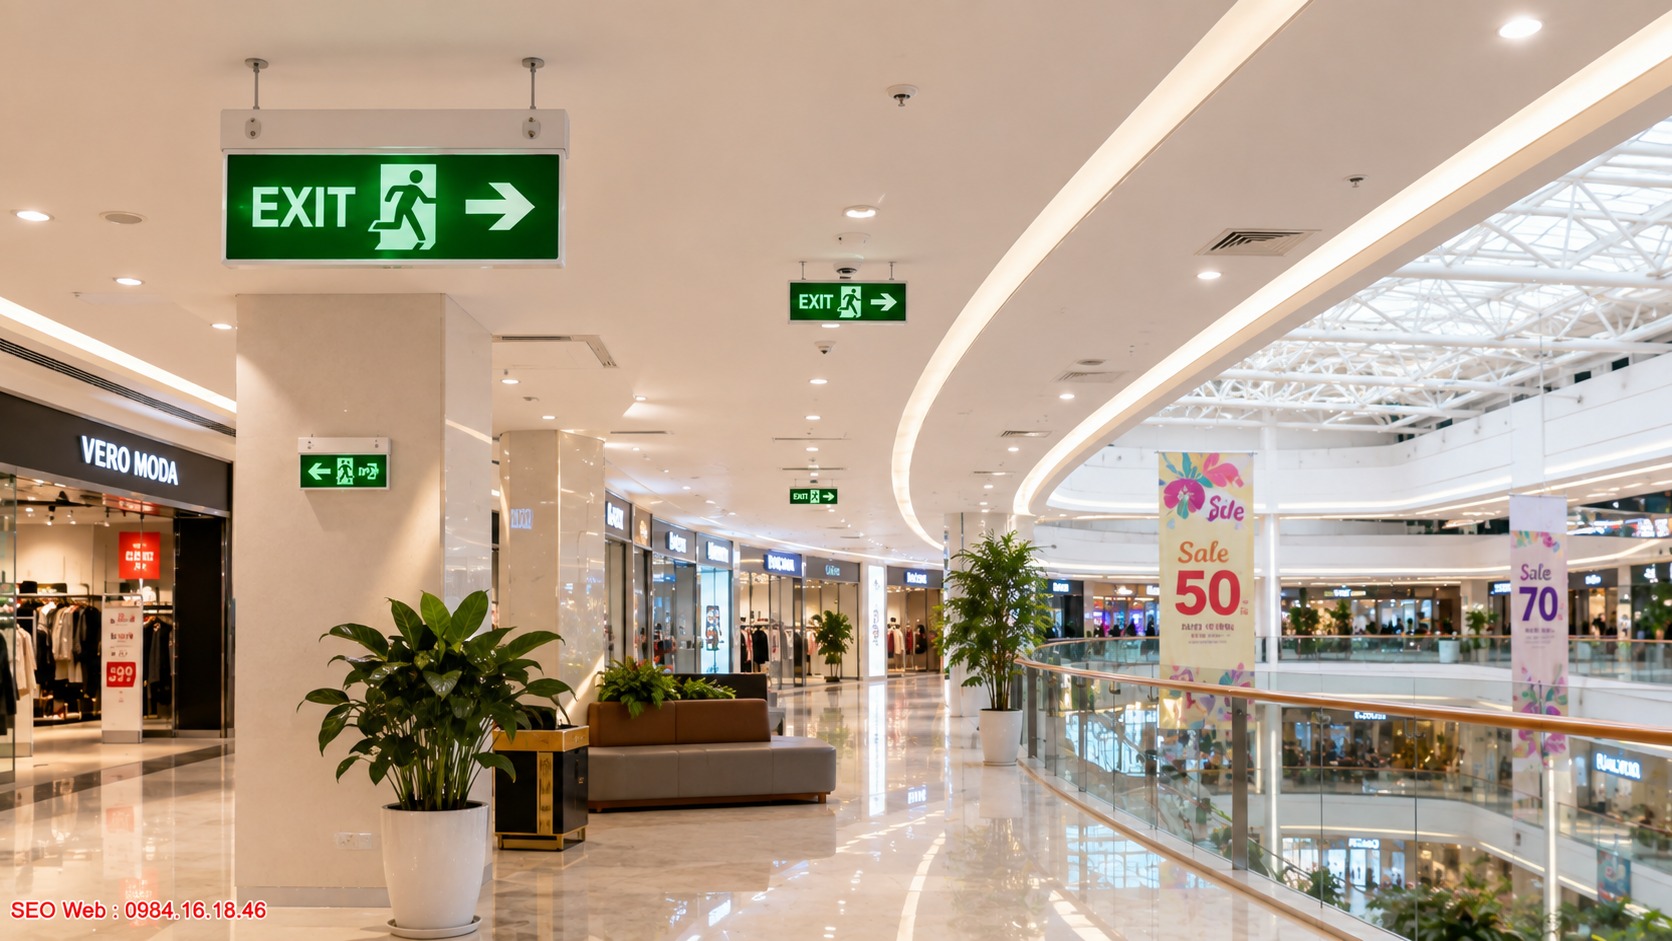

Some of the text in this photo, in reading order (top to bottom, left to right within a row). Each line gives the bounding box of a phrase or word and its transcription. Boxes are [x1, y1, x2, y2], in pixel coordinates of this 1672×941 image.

[252, 186, 356, 228] EXIT
[799, 294, 834, 310] EXIT
[81, 435, 179, 486] VERO MODA
[1177, 540, 1230, 564] Sale
[1520, 563, 1551, 581] Sale
[1174, 569, 1241, 616] 50
[1519, 586, 1558, 622] 70
